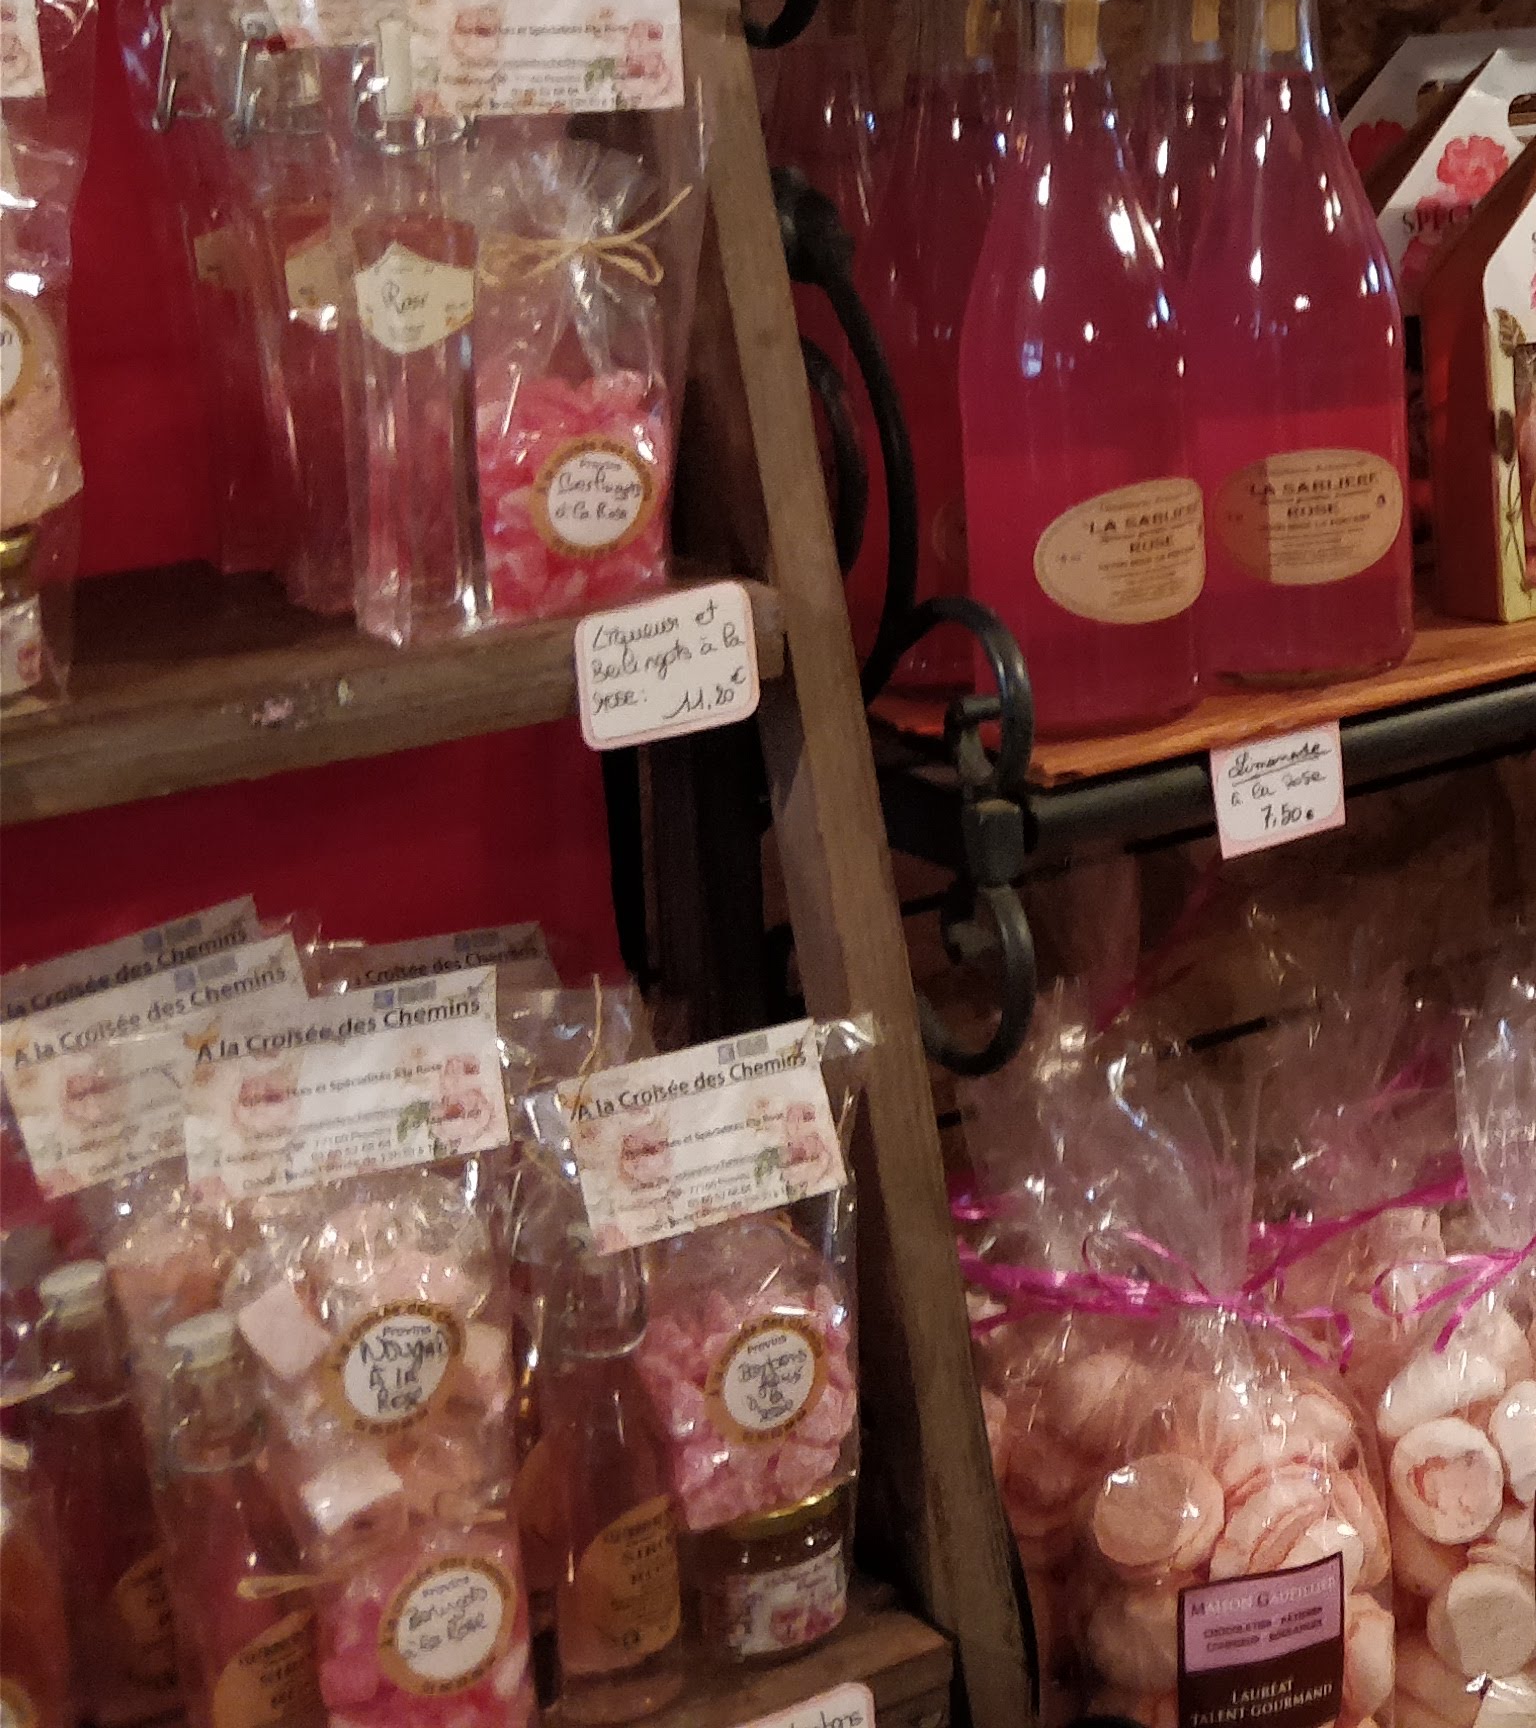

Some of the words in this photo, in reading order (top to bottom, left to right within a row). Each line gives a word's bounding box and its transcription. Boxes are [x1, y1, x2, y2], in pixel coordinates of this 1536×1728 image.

[1228, 742, 1332, 779] Limonade
[34, 1040, 55, 1064] la
[59, 1013, 142, 1053] Croisée
[147, 999, 185, 1023] des
[189, 964, 288, 1009] Chemins
[218, 1036, 239, 1058] la
[244, 1021, 333, 1053] Croisée
[338, 1015, 377, 1039] des
[382, 995, 482, 1030] Chemins
[595, 1095, 616, 1116] la
[618, 1080, 690, 1109] Croisée
[693, 1071, 726, 1091] des
[729, 1052, 808, 1083] Chemins
[1190, 1707, 1247, 1728] TALENT
[1250, 1683, 1333, 1717] GOURMAND
